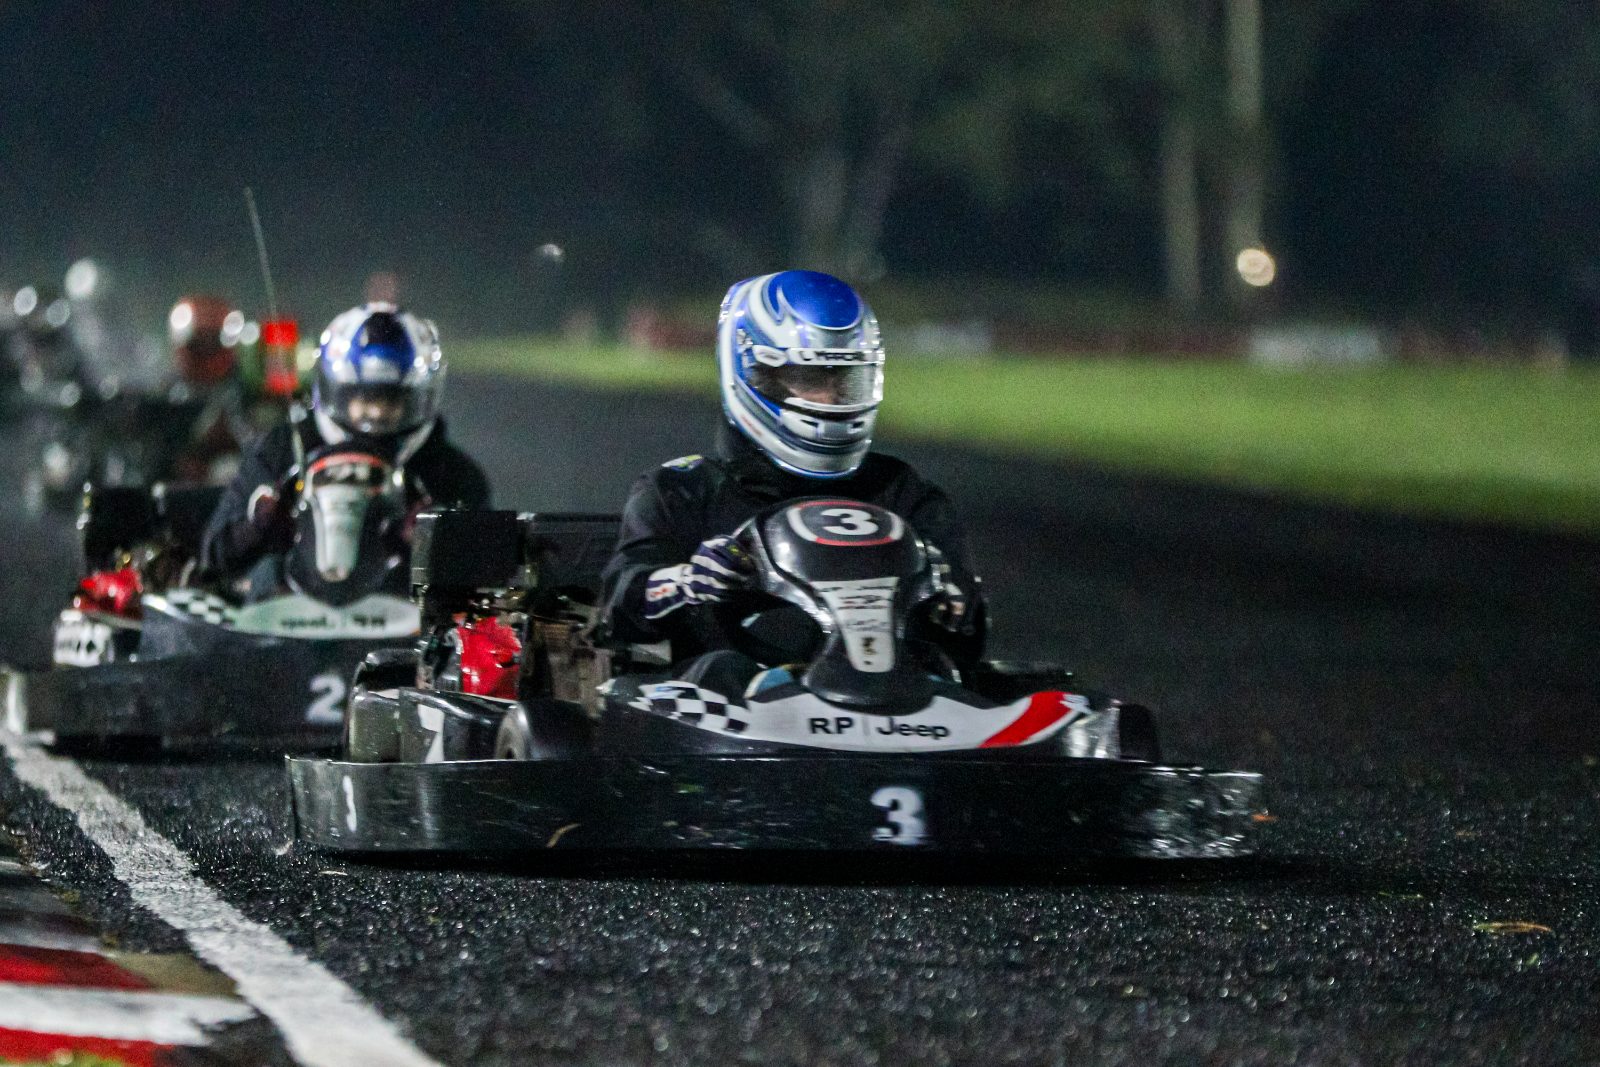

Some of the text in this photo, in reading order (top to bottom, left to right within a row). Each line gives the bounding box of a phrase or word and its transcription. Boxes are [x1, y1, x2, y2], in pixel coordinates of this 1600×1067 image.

[820, 508, 879, 535] 3
[305, 674, 346, 722] 2
[808, 716, 951, 739] RP Jeep
[870, 786, 927, 845] 3
